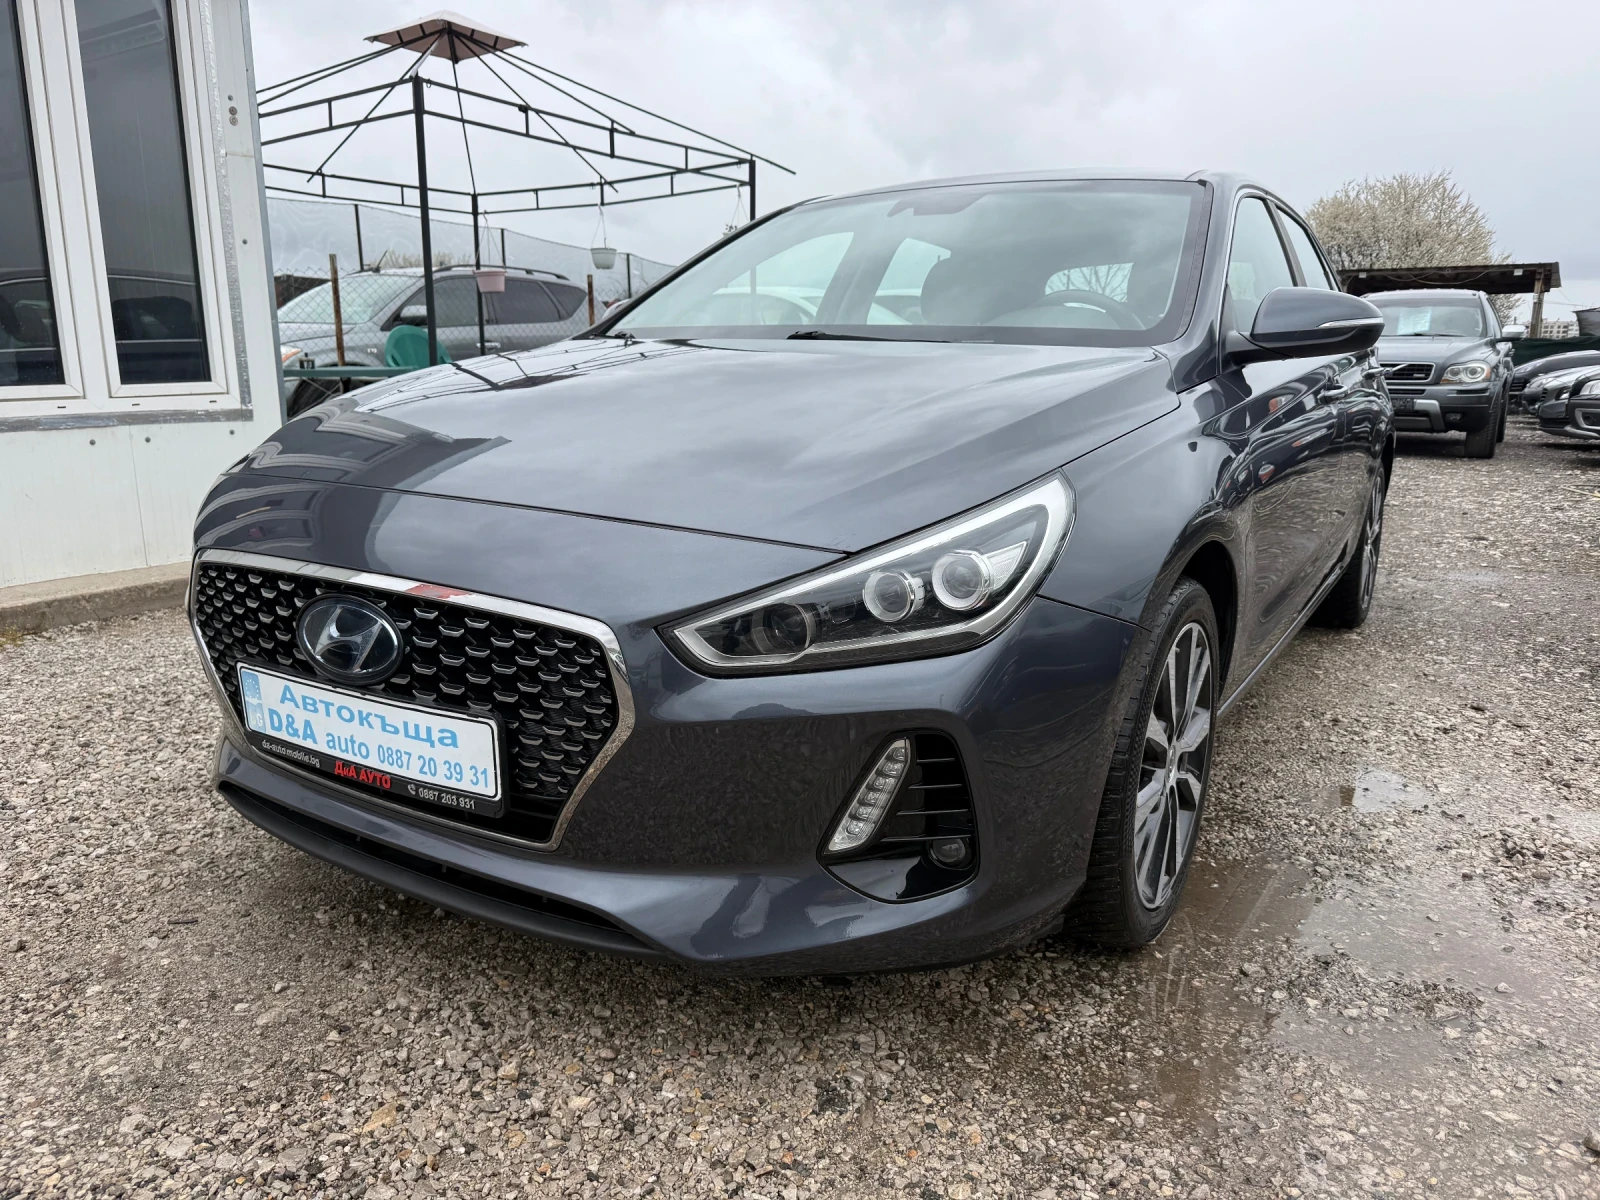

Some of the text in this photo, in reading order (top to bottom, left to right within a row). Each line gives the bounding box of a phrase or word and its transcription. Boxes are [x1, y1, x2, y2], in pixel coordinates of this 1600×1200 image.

[279, 684, 459, 749] Автокъща
[268, 707, 489, 788] D&A auto 0887 20 39 31
[360, 769, 391, 790] АУТО
[418, 787, 475, 811] 0887 203 931
